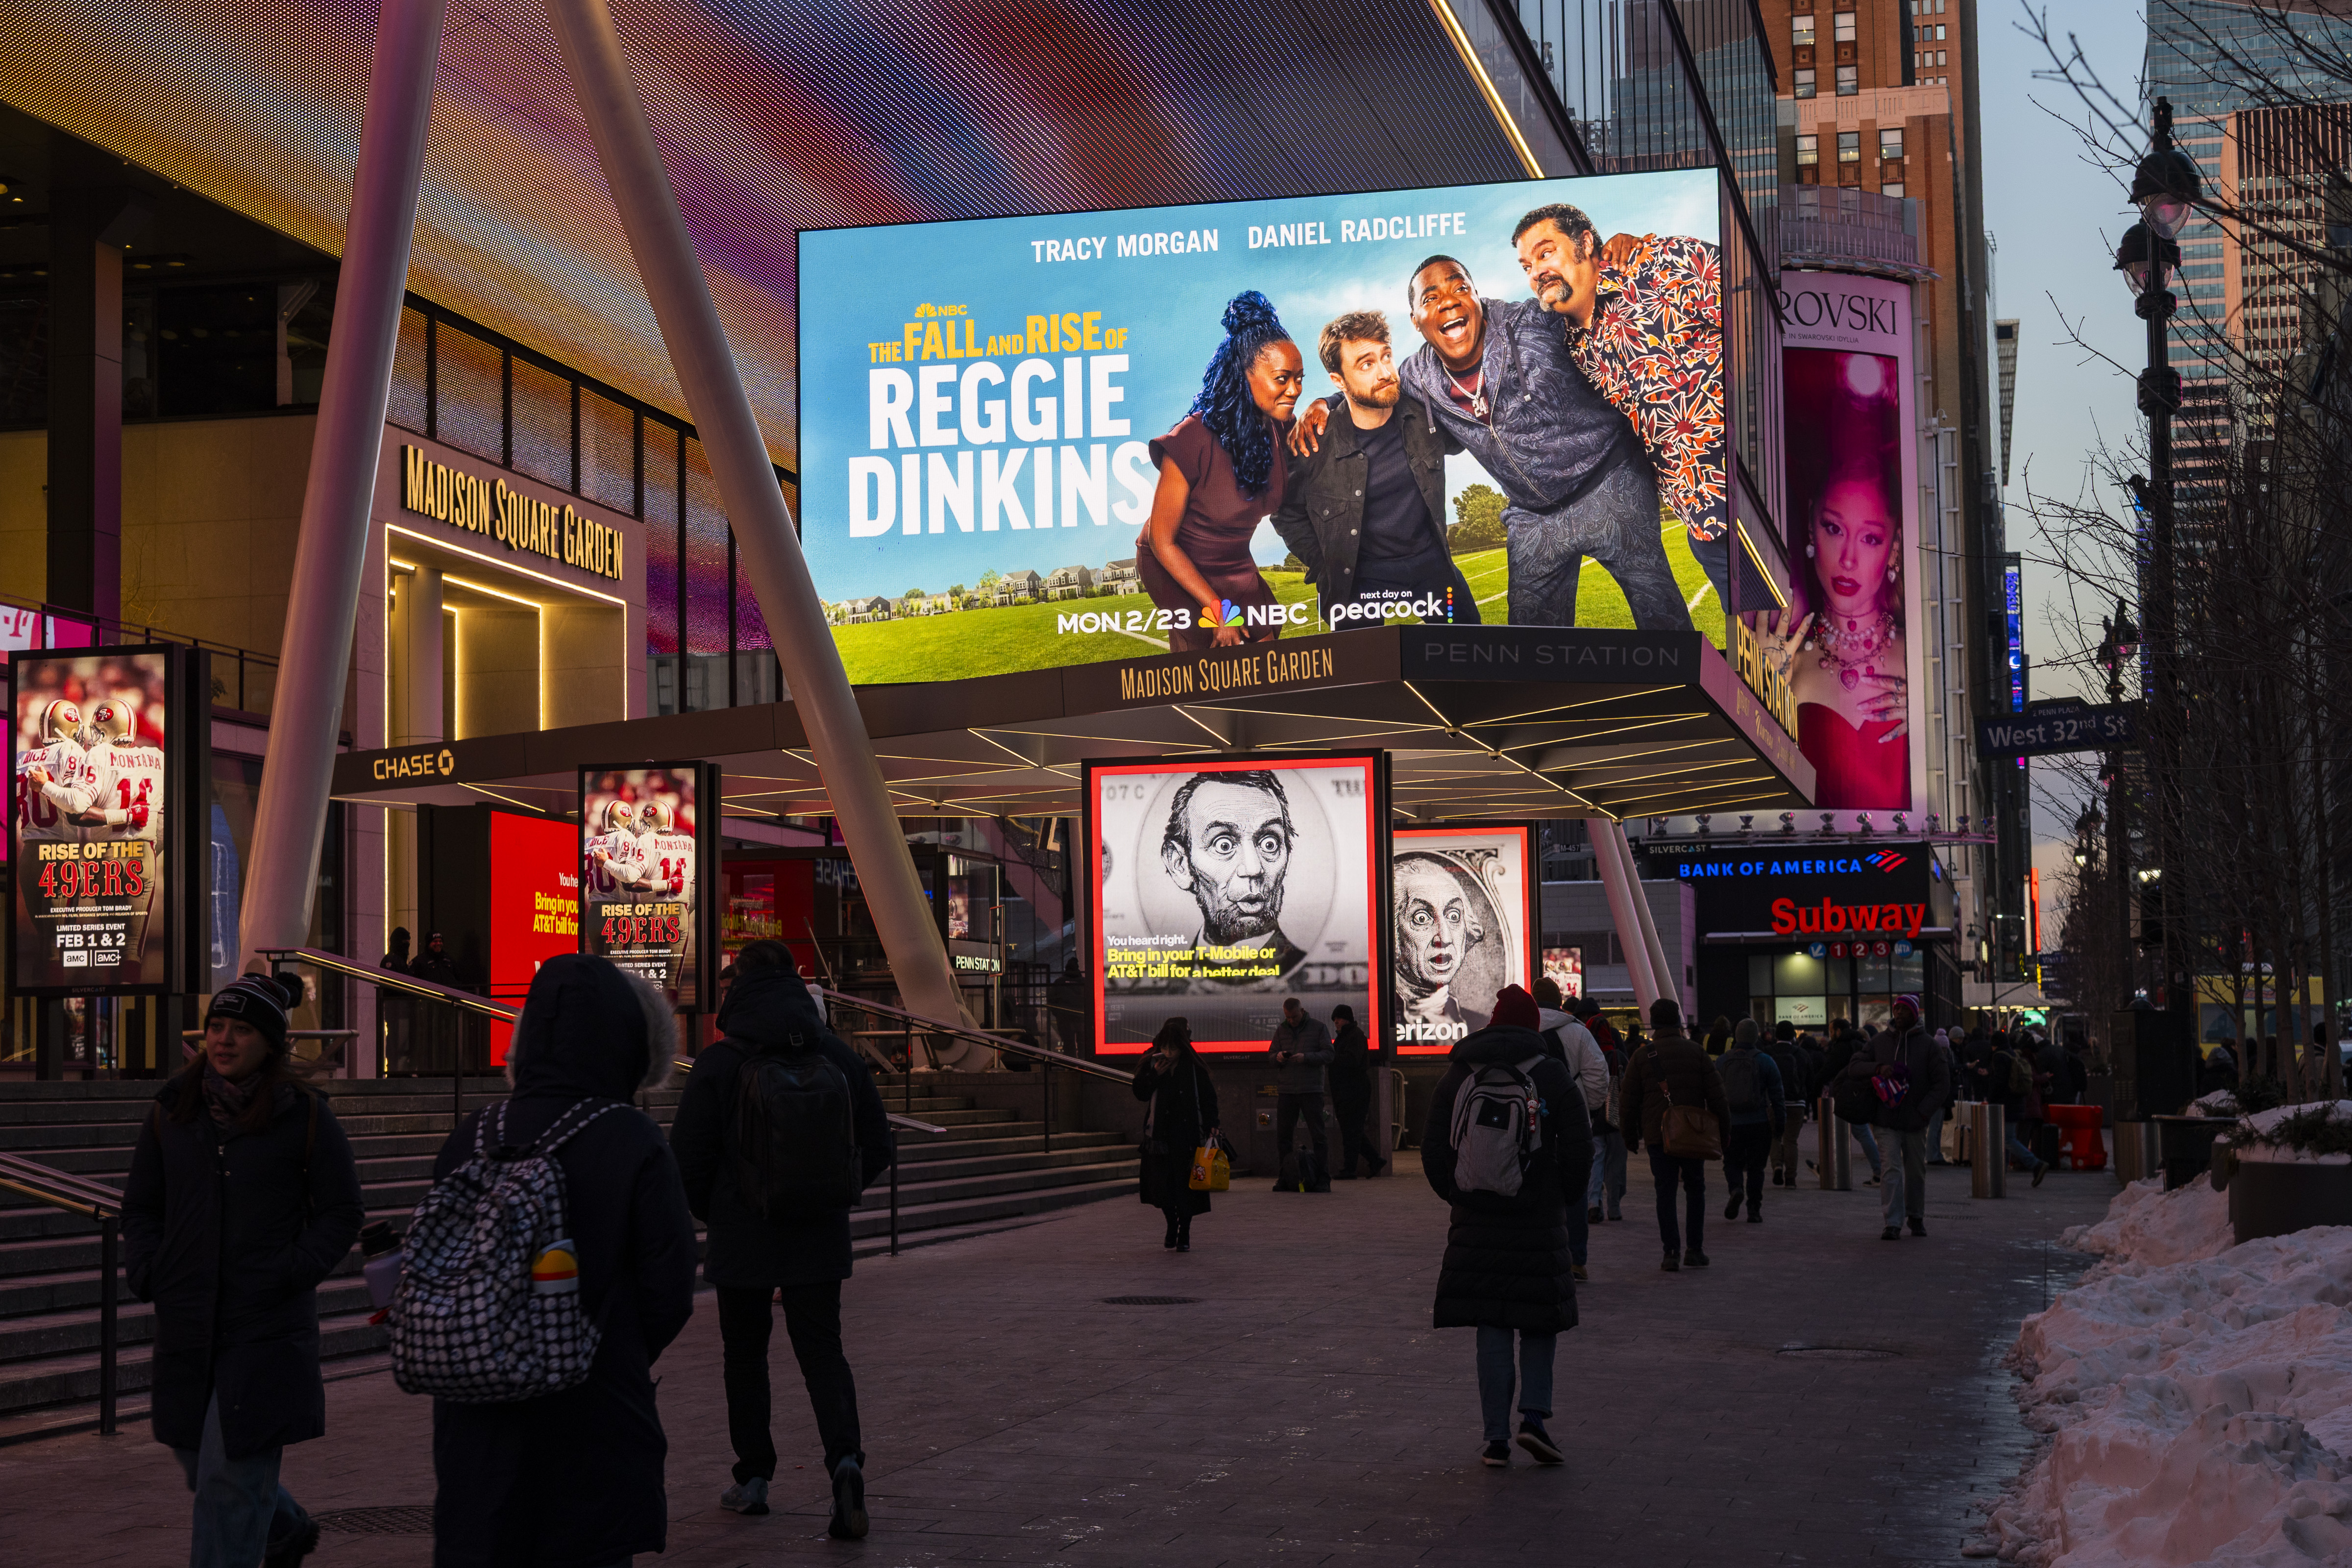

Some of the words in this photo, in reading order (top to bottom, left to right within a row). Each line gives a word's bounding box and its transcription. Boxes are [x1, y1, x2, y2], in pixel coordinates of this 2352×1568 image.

[1031, 237, 1108, 263] TRACY
[1117, 229, 1219, 258] MORGAN
[1249, 222, 1331, 248] DANIEL
[1342, 212, 1466, 243] RADCLIFFE
[938, 304, 968, 316] NBC
[1781, 291, 1898, 335] ROVSKI
[868, 342, 901, 363] THE
[904, 319, 983, 362] FALL
[986, 335, 1023, 356] AND
[1027, 311, 1102, 353] RISE
[1105, 328, 1128, 348] OF
[869, 354, 1131, 450] REGGIE
[1472, 397, 1488, 417] 24
[849, 441, 1154, 538] DINKINS
[407, 445, 490, 536] MADISON
[495, 479, 559, 551] SQUARE
[564, 505, 623, 580] GARDEN
[1361, 591, 1380, 600] next
[1383, 591, 1400, 600] day
[1058, 612, 1121, 635] MON
[1127, 608, 1191, 632] 2/23
[1248, 604, 1308, 626] NBC
[1330, 592, 1443, 632] peacock
[1425, 642, 1519, 663] PENN
[1535, 644, 1678, 666] STATION
[1121, 666, 1193, 700] MADISON
[1200, 657, 1261, 691] SQUARE
[1267, 648, 1333, 681] GARDEN
[1737, 614, 1764, 702] PENN
[1765, 655, 1798, 742] STATION
[1987, 724, 2046, 747] West
[2053, 715, 2096, 742] 32nd
[2105, 715, 2126, 736] St
[23, 748, 50, 764] RICE
[110, 752, 161, 770] MONTANA
[374, 754, 434, 780] CHASE
[39, 843, 79, 860] RISE
[83, 842, 106, 859] OF
[111, 841, 143, 858] THE
[589, 835, 610, 847] RICE
[654, 839, 692, 852] MONTANA
[1649, 845, 1706, 854] SILVERCAST
[1679, 862, 1734, 877] BANK
[1740, 862, 1764, 876] OF
[1769, 858, 1862, 875] AMERICA
[39, 860, 143, 897] 49ERS
[559, 872, 570, 886] You
[535, 891, 557, 915] Bring
[558, 894, 564, 912] in
[565, 899, 578, 916] you
[602, 904, 632, 916] RISE
[635, 904, 653, 915] OF
[655, 903, 680, 915] THE
[533, 914, 555, 933] AT&T
[556, 916, 567, 934] bill
[1771, 897, 1926, 938] Subway
[602, 917, 680, 943] 49ERS
[57, 934, 83, 948] FEB
[88, 934, 97, 947] 1
[101, 933, 112, 946] &
[117, 933, 125, 946] 2
[1107, 935, 1127, 946] You
[1128, 935, 1158, 946] heard
[1160, 934, 1187, 947] right.
[1835, 945, 1841, 956] 1
[1856, 944, 1864, 956] 2
[1877, 943, 1886, 955] 3
[956, 956, 974, 969] PENN
[975, 957, 1000, 972] STATON
[1107, 948, 1145, 964] Bring
[1147, 948, 1160, 961] in
[1162, 949, 1195, 963] your
[1196, 946, 1258, 960] T-Mobile
[1260, 948, 1275, 958] or
[638, 969, 645, 978] 1
[648, 969, 657, 978] &
[660, 969, 666, 979] 2
[1107, 964, 1146, 978] AT&T
[1148, 963, 1168, 977] bill
[1170, 965, 1191, 977] for
[1396, 1018, 1468, 1041] erizon
